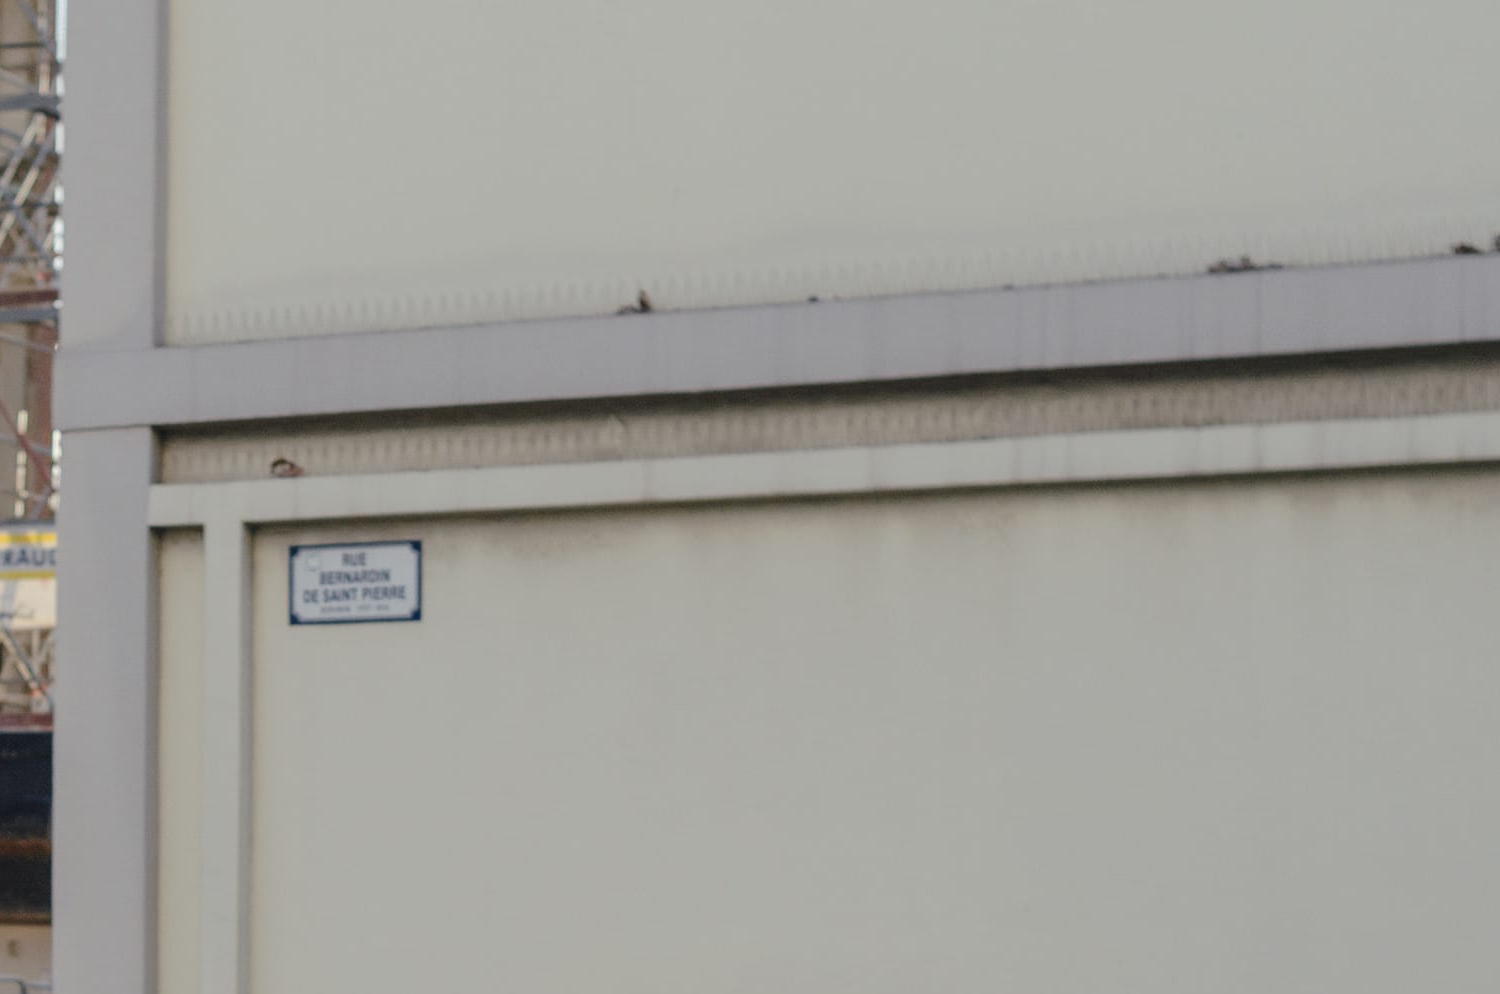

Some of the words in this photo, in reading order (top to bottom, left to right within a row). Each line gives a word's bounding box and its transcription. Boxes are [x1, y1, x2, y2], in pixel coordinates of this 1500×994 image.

[342, 552, 367, 567] RUE
[320, 569, 391, 585] BERNARDIN
[303, 589, 319, 604] DE
[323, 587, 358, 603] SAINT
[361, 584, 406, 600] PIERRE
